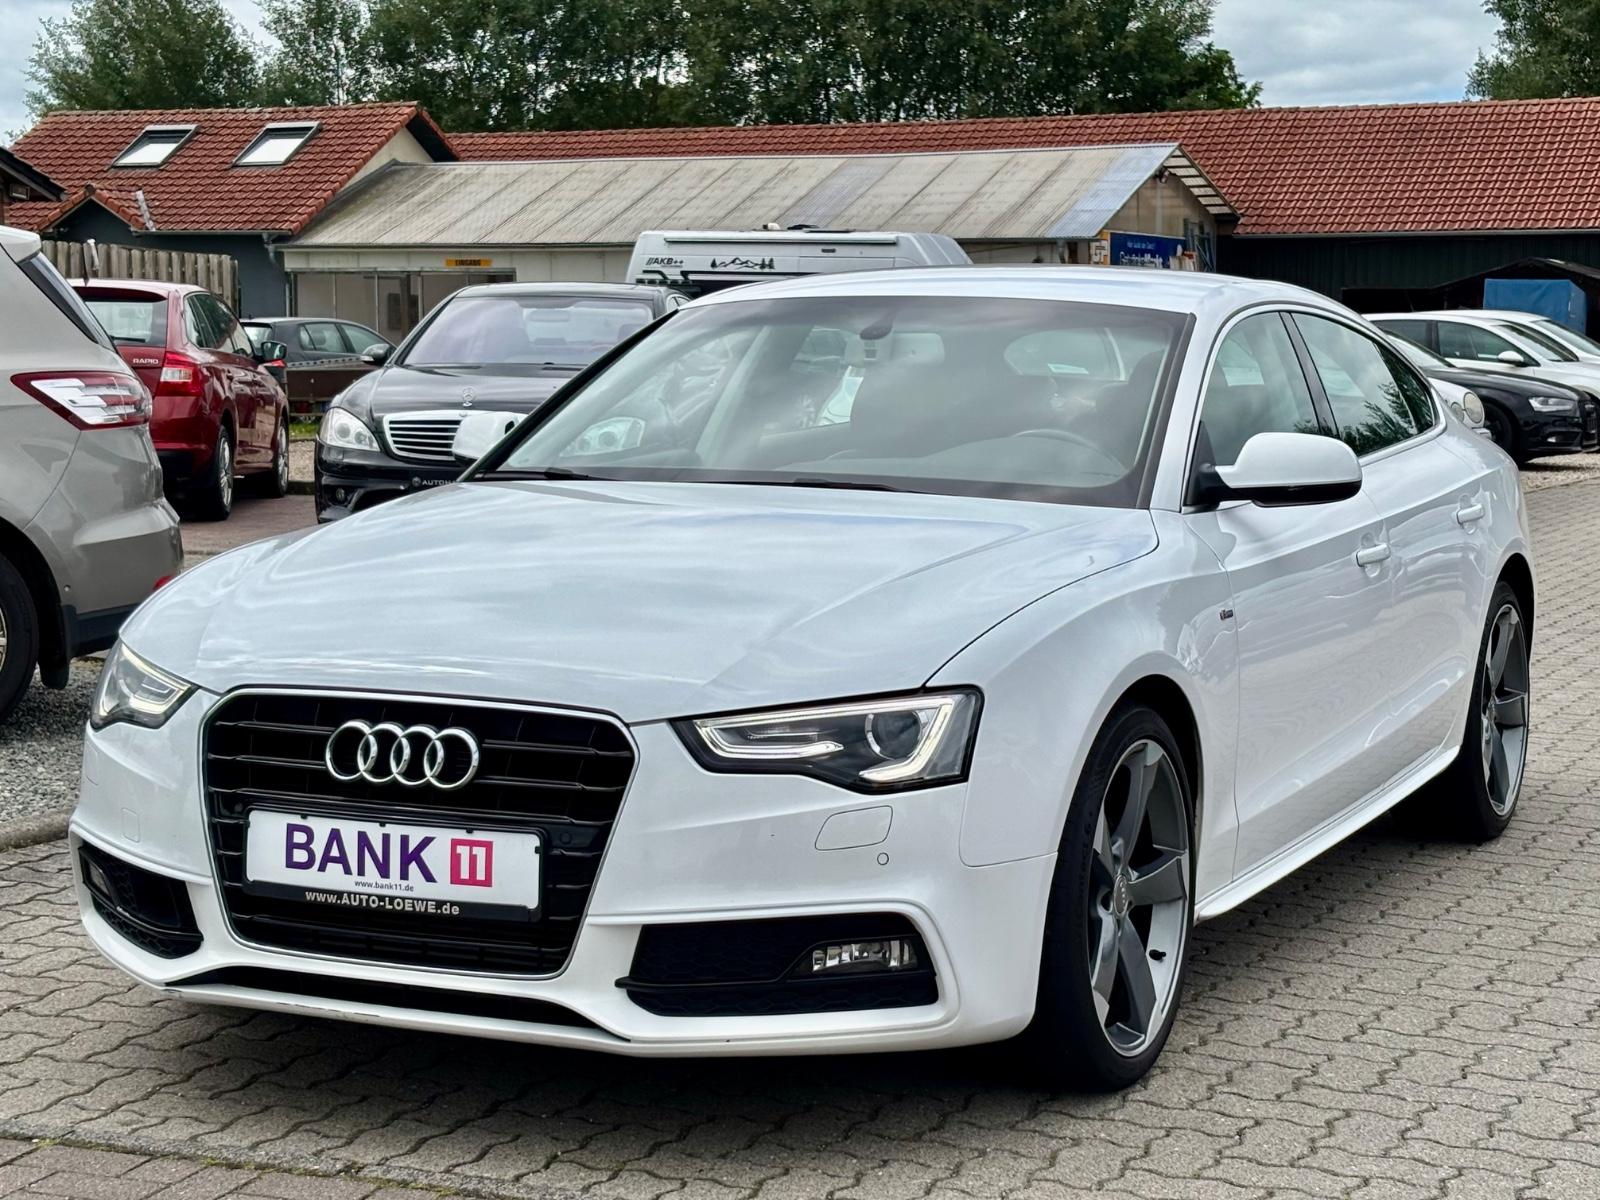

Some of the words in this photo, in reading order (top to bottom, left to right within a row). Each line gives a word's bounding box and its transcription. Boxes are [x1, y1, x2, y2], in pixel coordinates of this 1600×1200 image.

[285, 823, 438, 884] BANK
[456, 845, 486, 881] 11
[354, 880, 414, 892] www.bank11.de
[305, 890, 460, 915] www.AUTO-LOEWE.de
